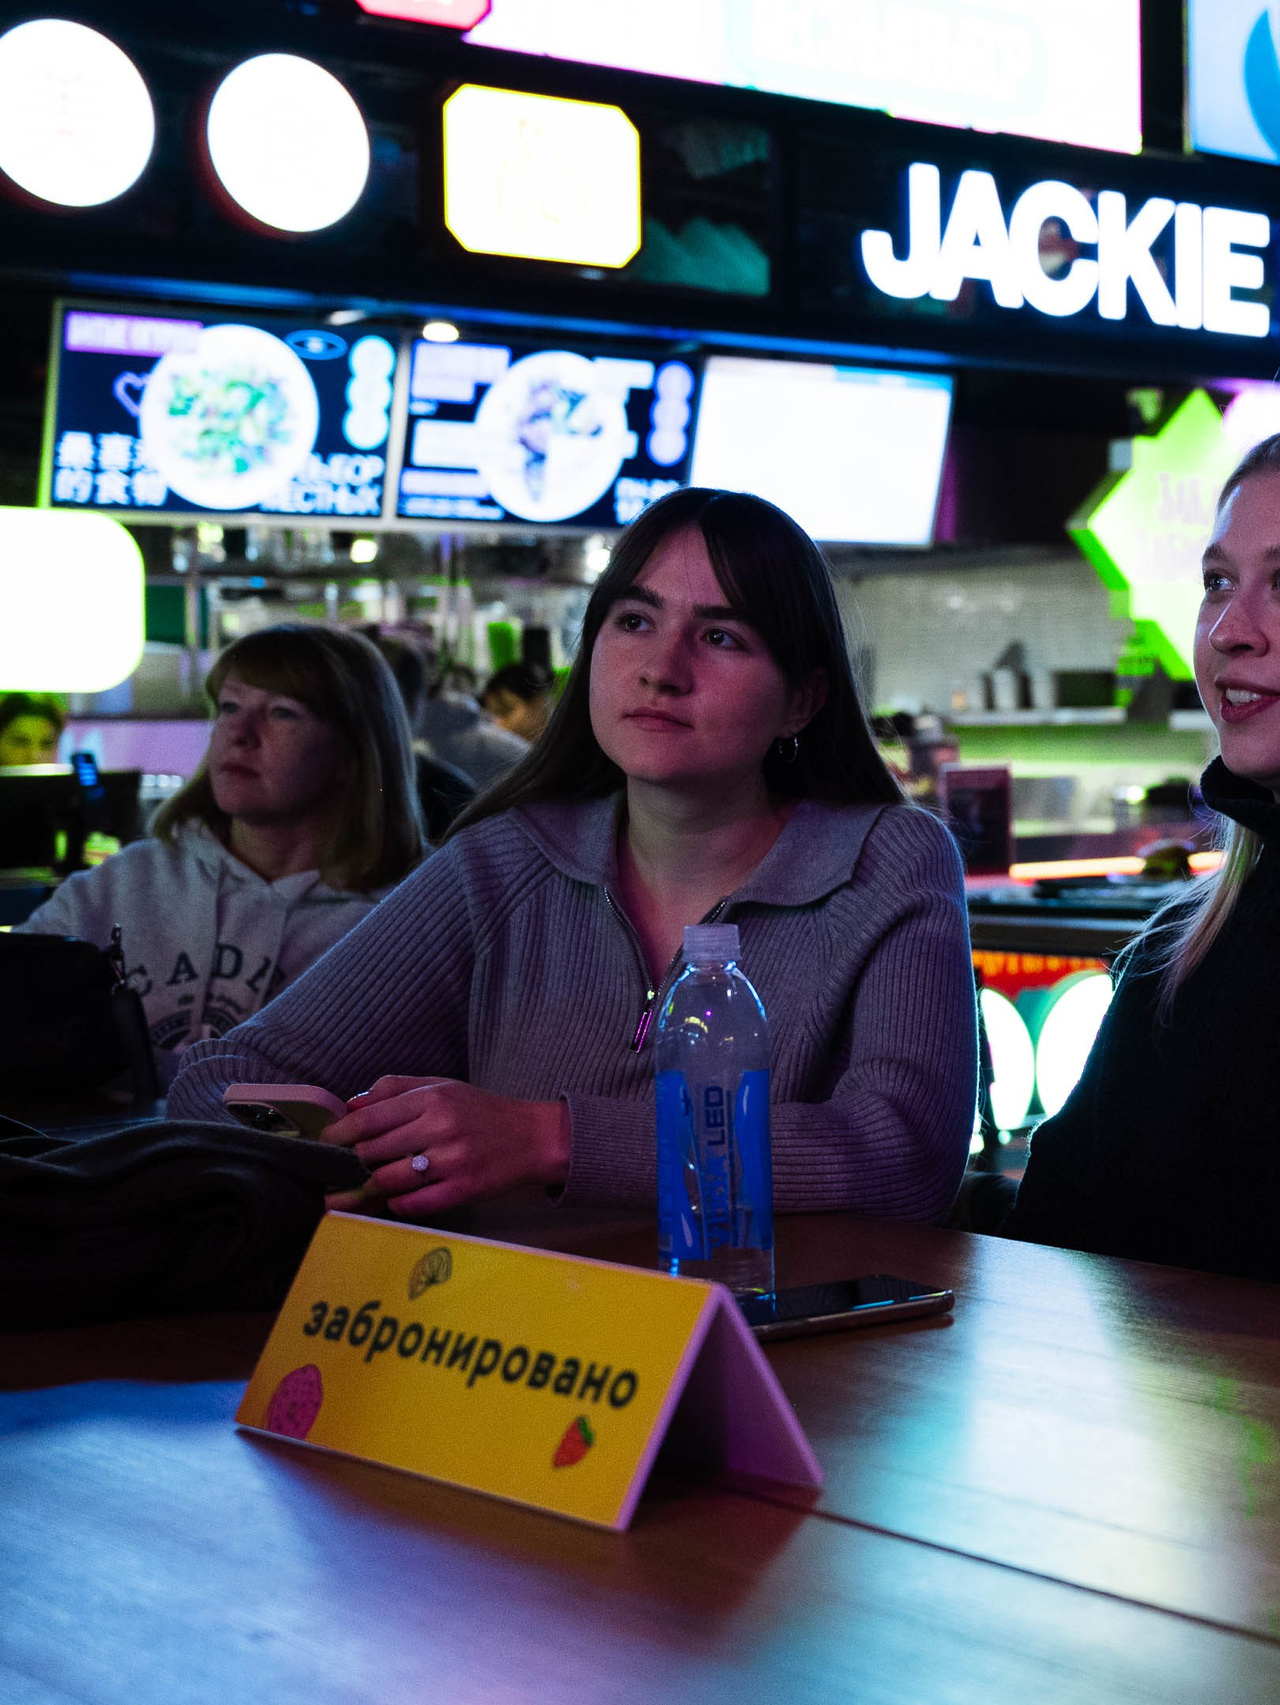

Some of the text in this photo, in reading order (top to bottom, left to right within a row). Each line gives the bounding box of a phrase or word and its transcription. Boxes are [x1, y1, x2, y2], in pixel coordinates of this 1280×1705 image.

[861, 162, 1271, 338] JACKIE
[703, 1085, 726, 1147] LED
[303, 1300, 640, 1409] забронировано
